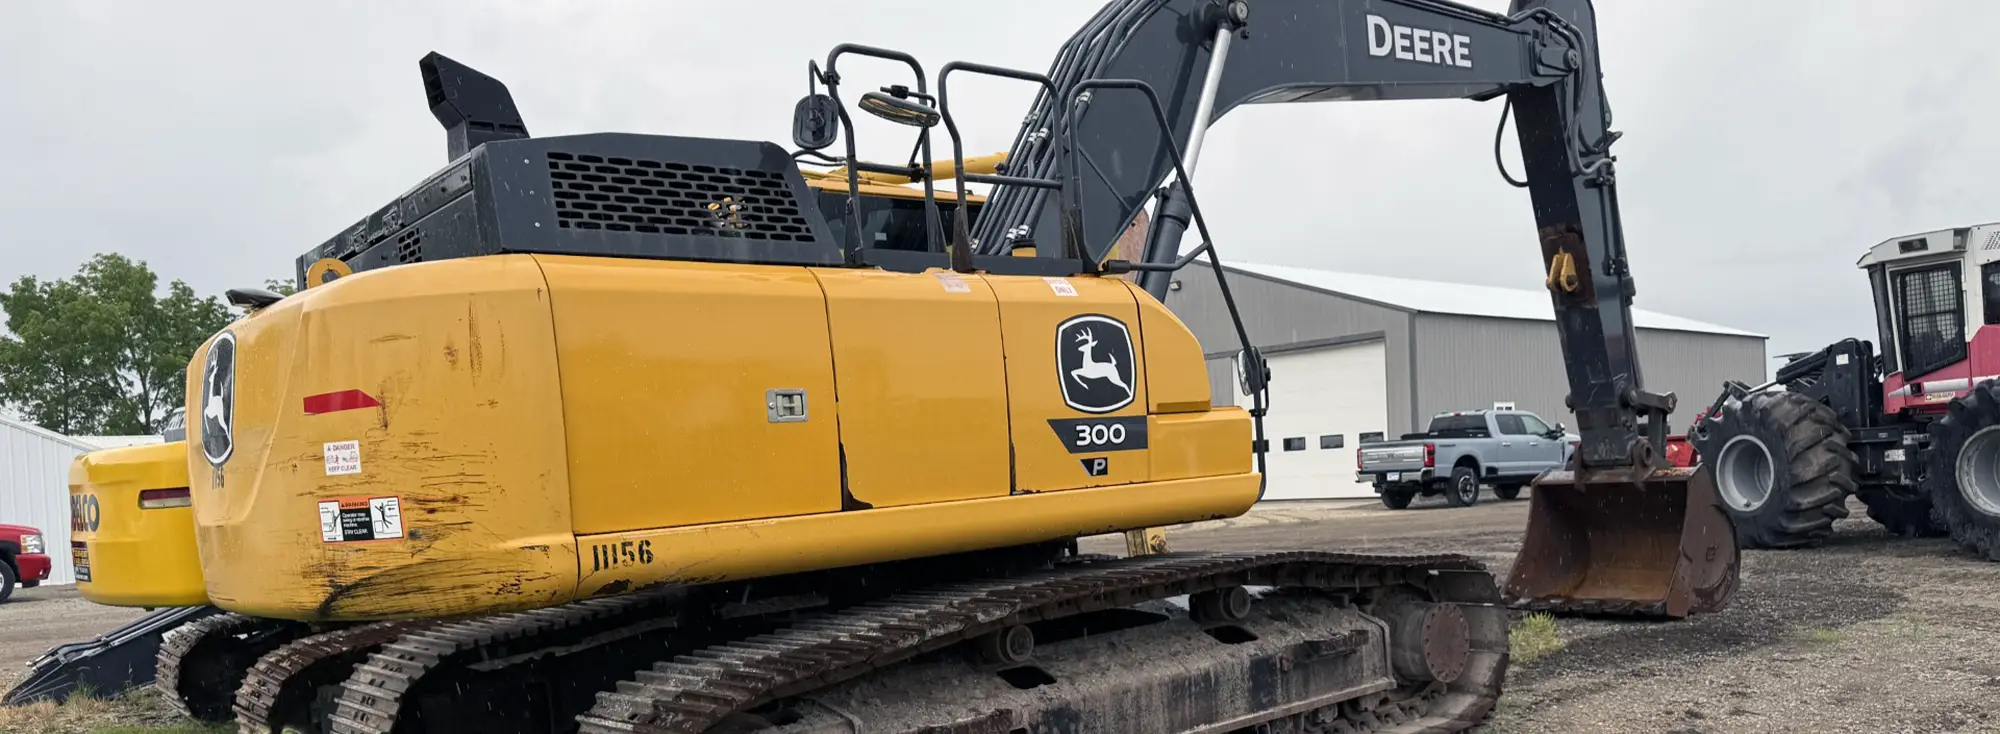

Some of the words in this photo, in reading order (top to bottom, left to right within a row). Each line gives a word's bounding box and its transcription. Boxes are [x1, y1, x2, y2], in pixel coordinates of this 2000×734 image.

[1366, 14, 1472, 68] DEERE
[1075, 423, 1126, 446] 300
[332, 443, 355, 451] DANGER
[1092, 458, 1106, 475] P
